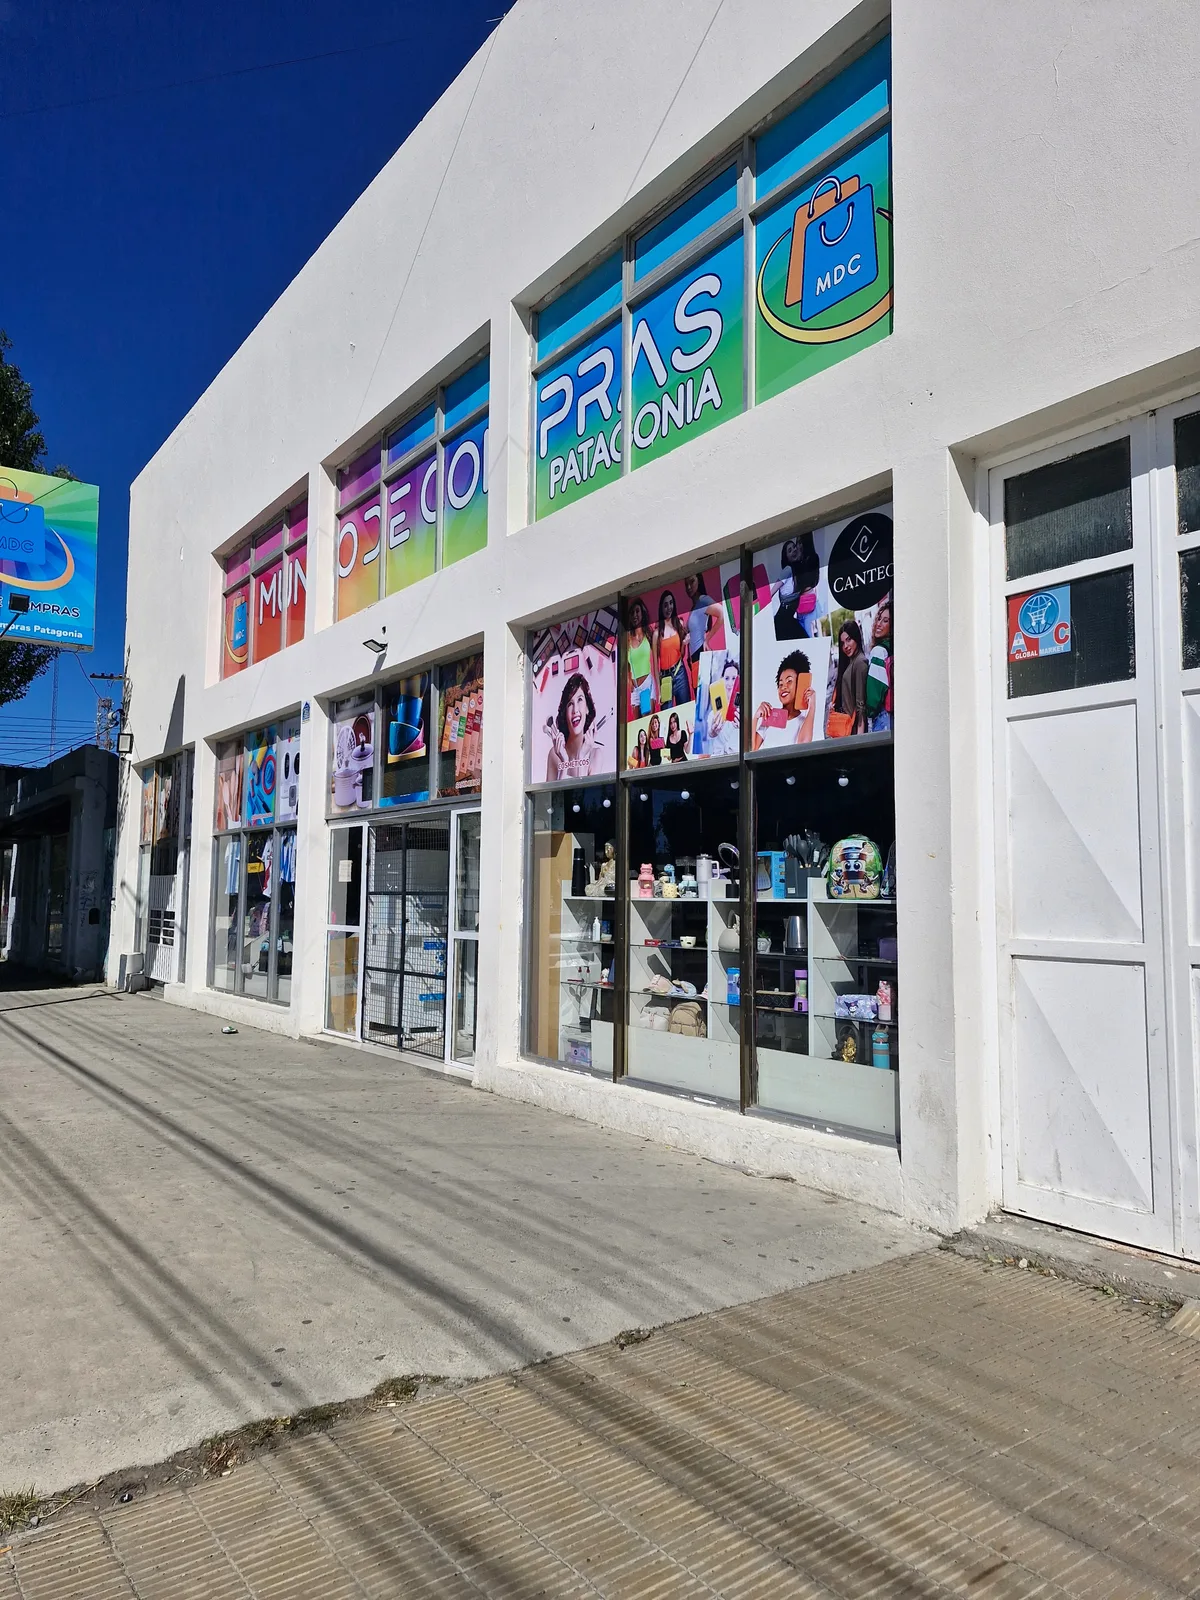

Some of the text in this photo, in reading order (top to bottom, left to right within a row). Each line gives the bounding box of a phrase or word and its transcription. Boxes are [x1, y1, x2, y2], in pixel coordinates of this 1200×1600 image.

[815, 253, 862, 297] MDC
[548, 367, 723, 500] PATAGONIA
[9, 600, 80, 618] MPRAS
[34, 624, 83, 639] Patagonia
[1015, 645, 1064, 659] GLOBAL MARKET
